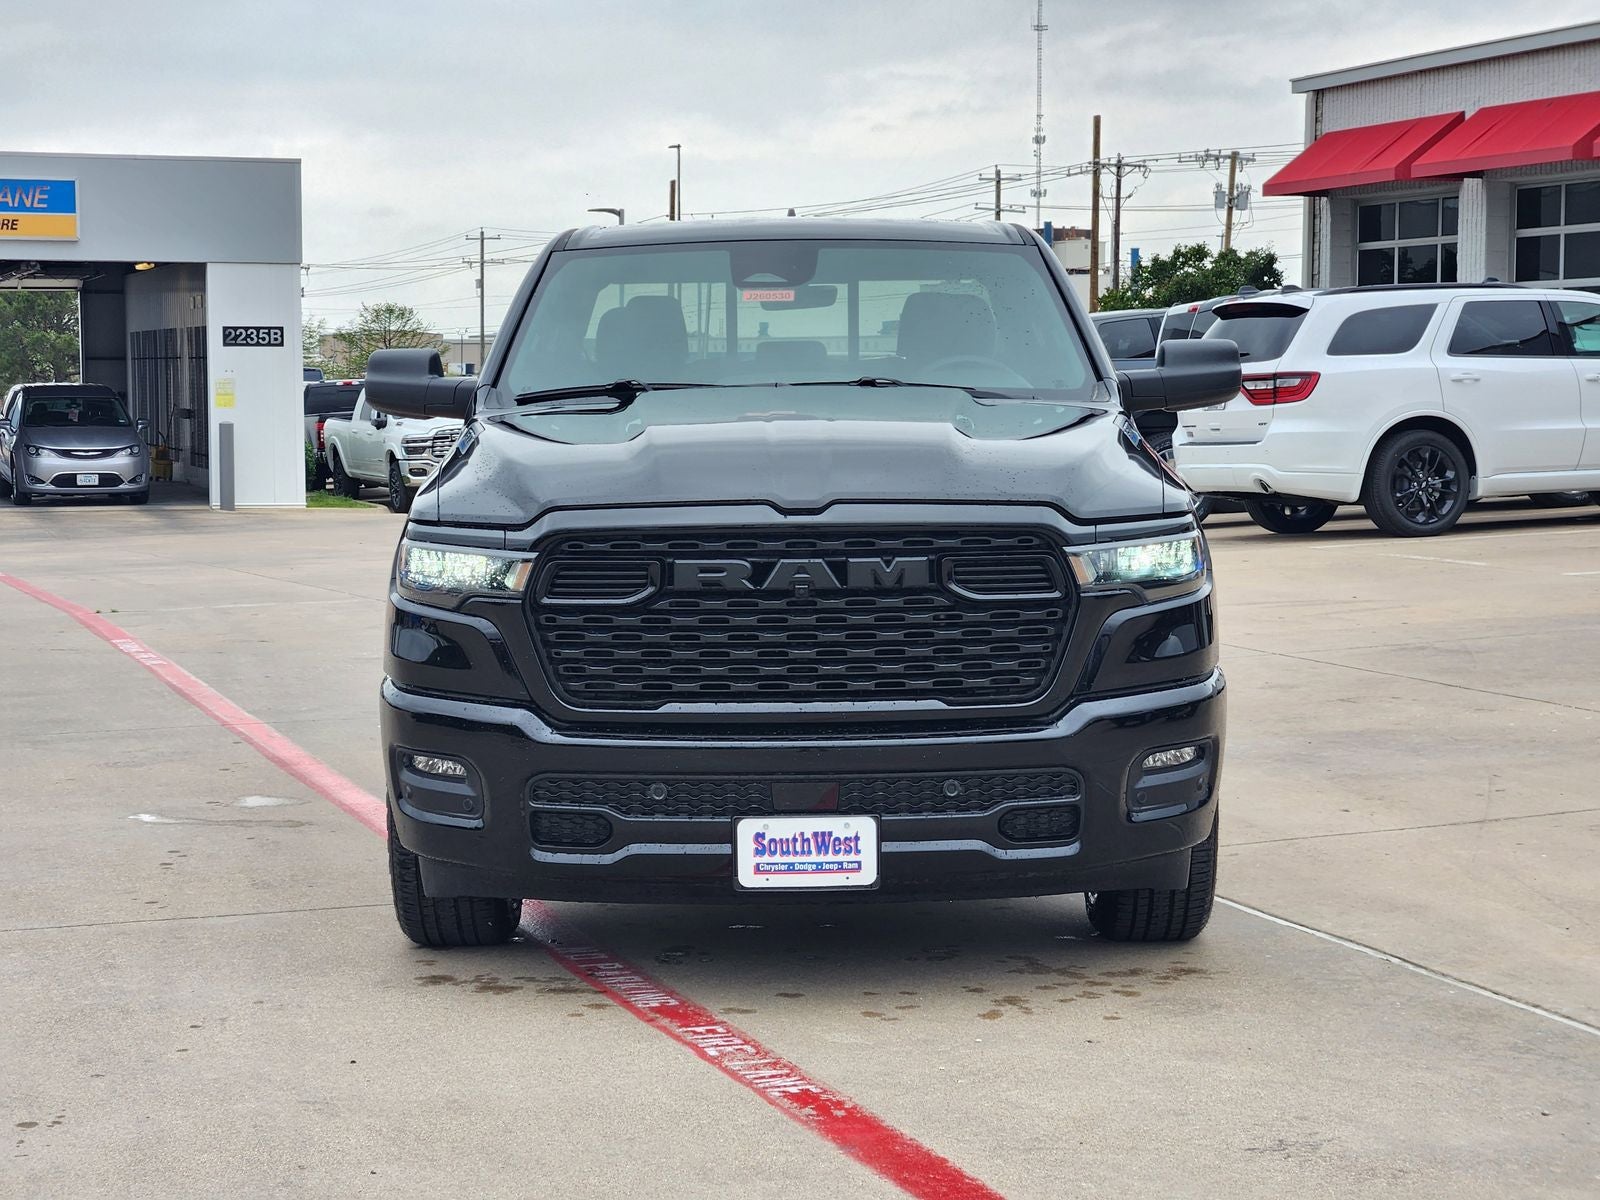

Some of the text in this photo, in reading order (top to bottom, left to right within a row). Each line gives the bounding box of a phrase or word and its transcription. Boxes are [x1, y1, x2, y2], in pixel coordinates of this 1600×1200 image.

[224, 328, 282, 345] 2235B
[673, 556, 929, 590] RAM
[752, 830, 862, 858] SouthWest
[759, 861, 859, 872] Chrysler Dodge Jeep Ram
[676, 1024, 757, 1057] FIRE
